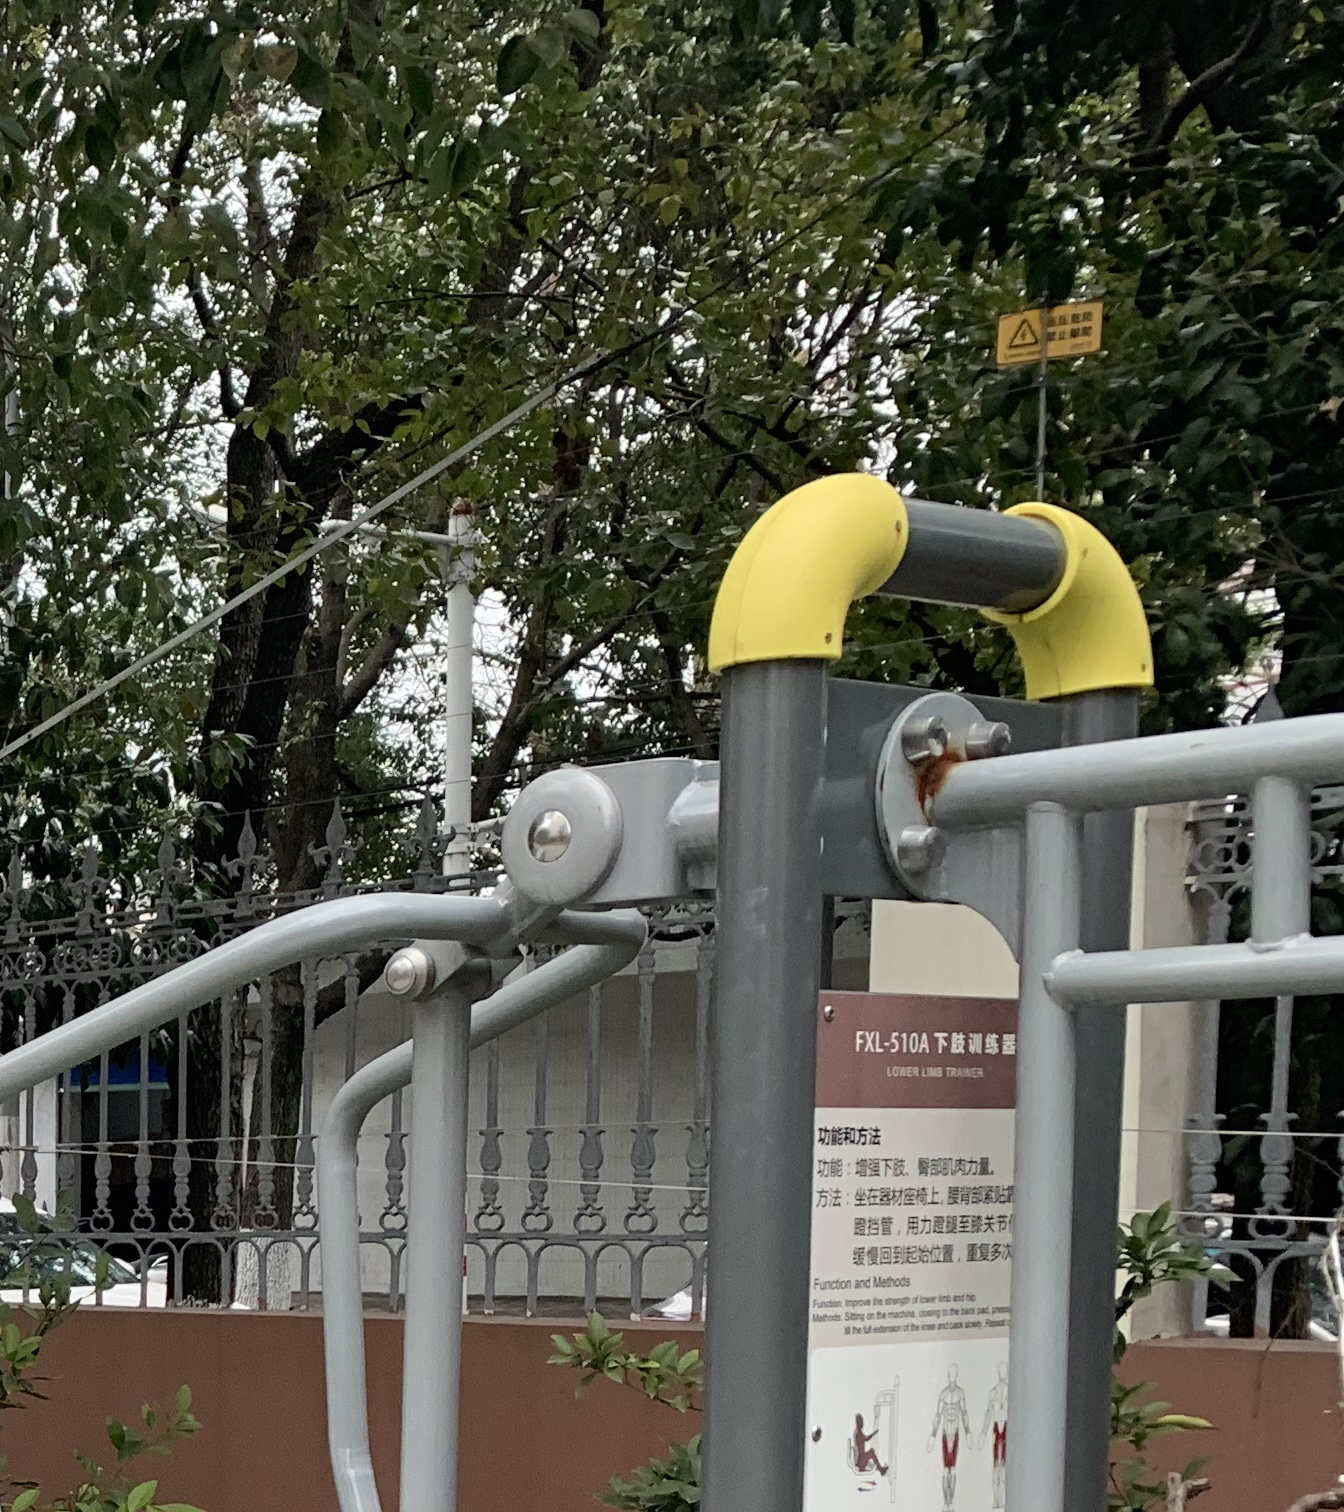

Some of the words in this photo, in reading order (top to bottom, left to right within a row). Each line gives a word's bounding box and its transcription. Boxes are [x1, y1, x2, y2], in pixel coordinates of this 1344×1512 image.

[855, 1031, 930, 1053] FXL-510A
[934, 1032, 1017, 1055] 下肢训练器
[887, 1066, 919, 1077] LOWER
[922, 1067, 943, 1078] LIMB
[946, 1067, 984, 1078] TRAINER
[817, 1126, 881, 1146] 功能和方法
[814, 1278, 851, 1290] Function
[854, 1277, 871, 1288] and
[873, 1276, 910, 1288] Methods
